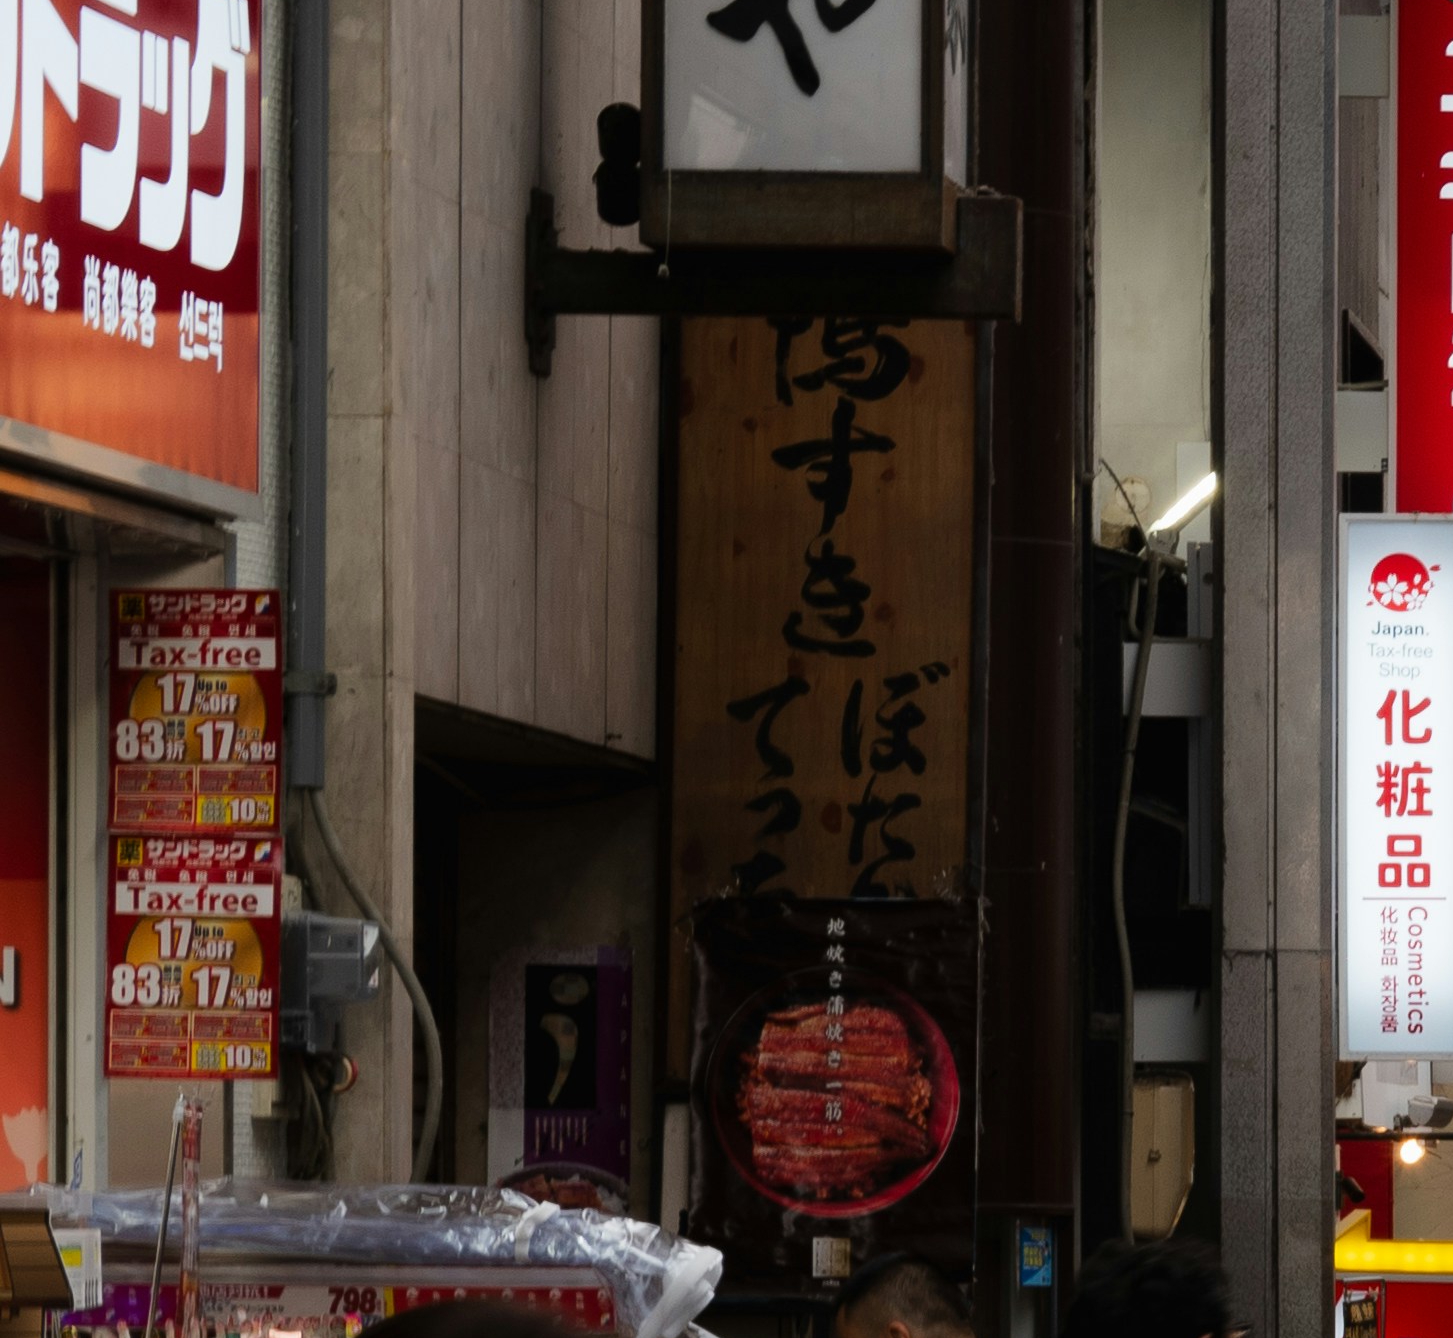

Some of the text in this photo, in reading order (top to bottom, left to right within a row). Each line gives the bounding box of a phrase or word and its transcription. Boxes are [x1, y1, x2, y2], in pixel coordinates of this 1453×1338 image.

[129, 639, 262, 667] Tax-free
[1367, 643, 1433, 659] Tax-free
[1378, 663, 1421, 679] Shop
[156, 673, 197, 715] 17
[116, 719, 165, 762] 83
[196, 719, 235, 762] 17
[1376, 689, 1433, 888] 化粧品
[127, 884, 260, 913] Tax-free
[154, 918, 193, 960] 17
[112, 963, 161, 1007] 83
[192, 965, 232, 1008] 17
[1380, 906, 1398, 1035] 化妆品 화장품
[1406, 906, 1429, 1035] Cosmetics
[328, 1286, 377, 1314] 798
